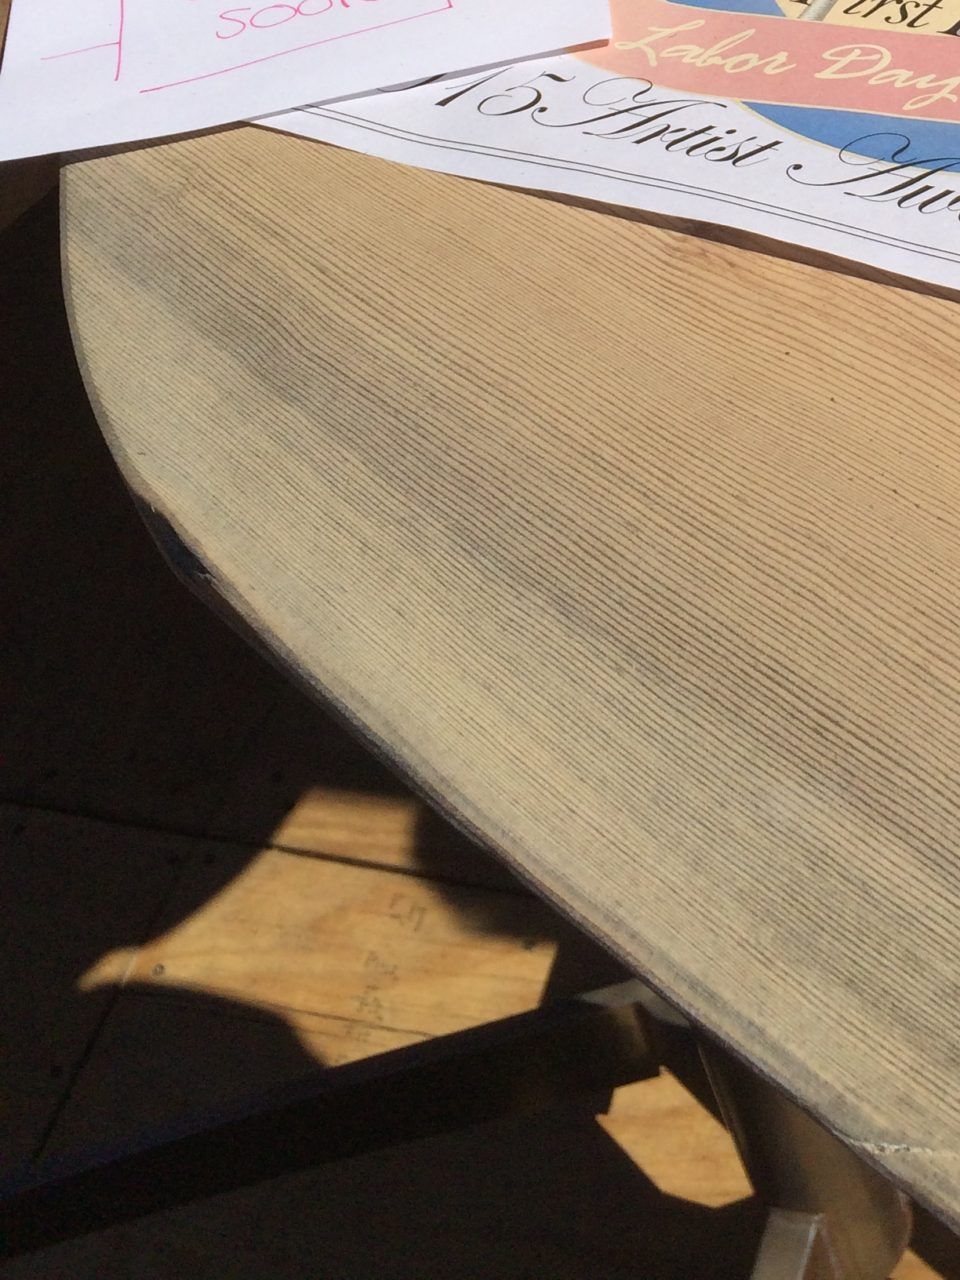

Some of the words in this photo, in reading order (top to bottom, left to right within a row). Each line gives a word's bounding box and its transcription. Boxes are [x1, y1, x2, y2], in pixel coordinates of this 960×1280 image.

[614, 19, 795, 79] Labor
[821, 45, 957, 113] Day
[531, 77, 776, 169] Artist
